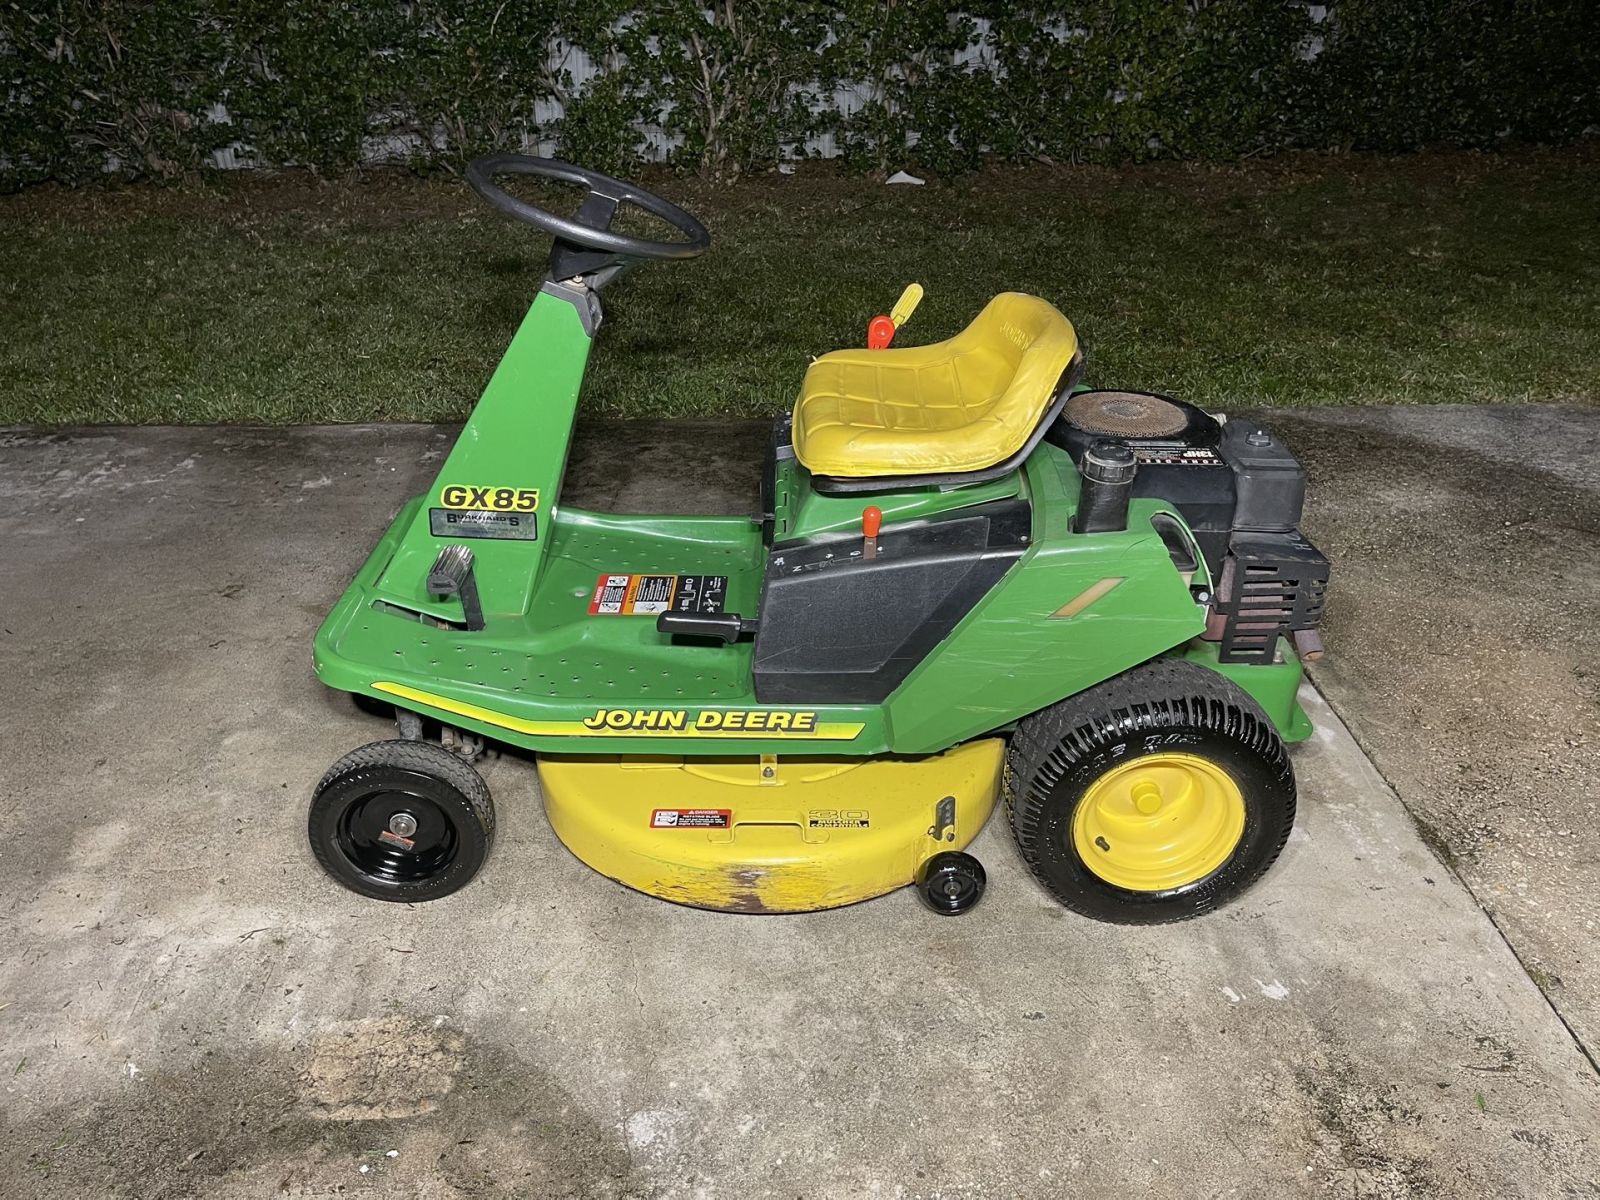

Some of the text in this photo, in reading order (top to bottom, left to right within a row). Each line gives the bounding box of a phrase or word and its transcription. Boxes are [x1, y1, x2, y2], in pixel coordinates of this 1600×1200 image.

[1183, 450, 1215, 458] 13HP
[442, 485, 538, 511] GX85
[584, 710, 818, 732] JOHN DEERE
[809, 810, 870, 820] 30
